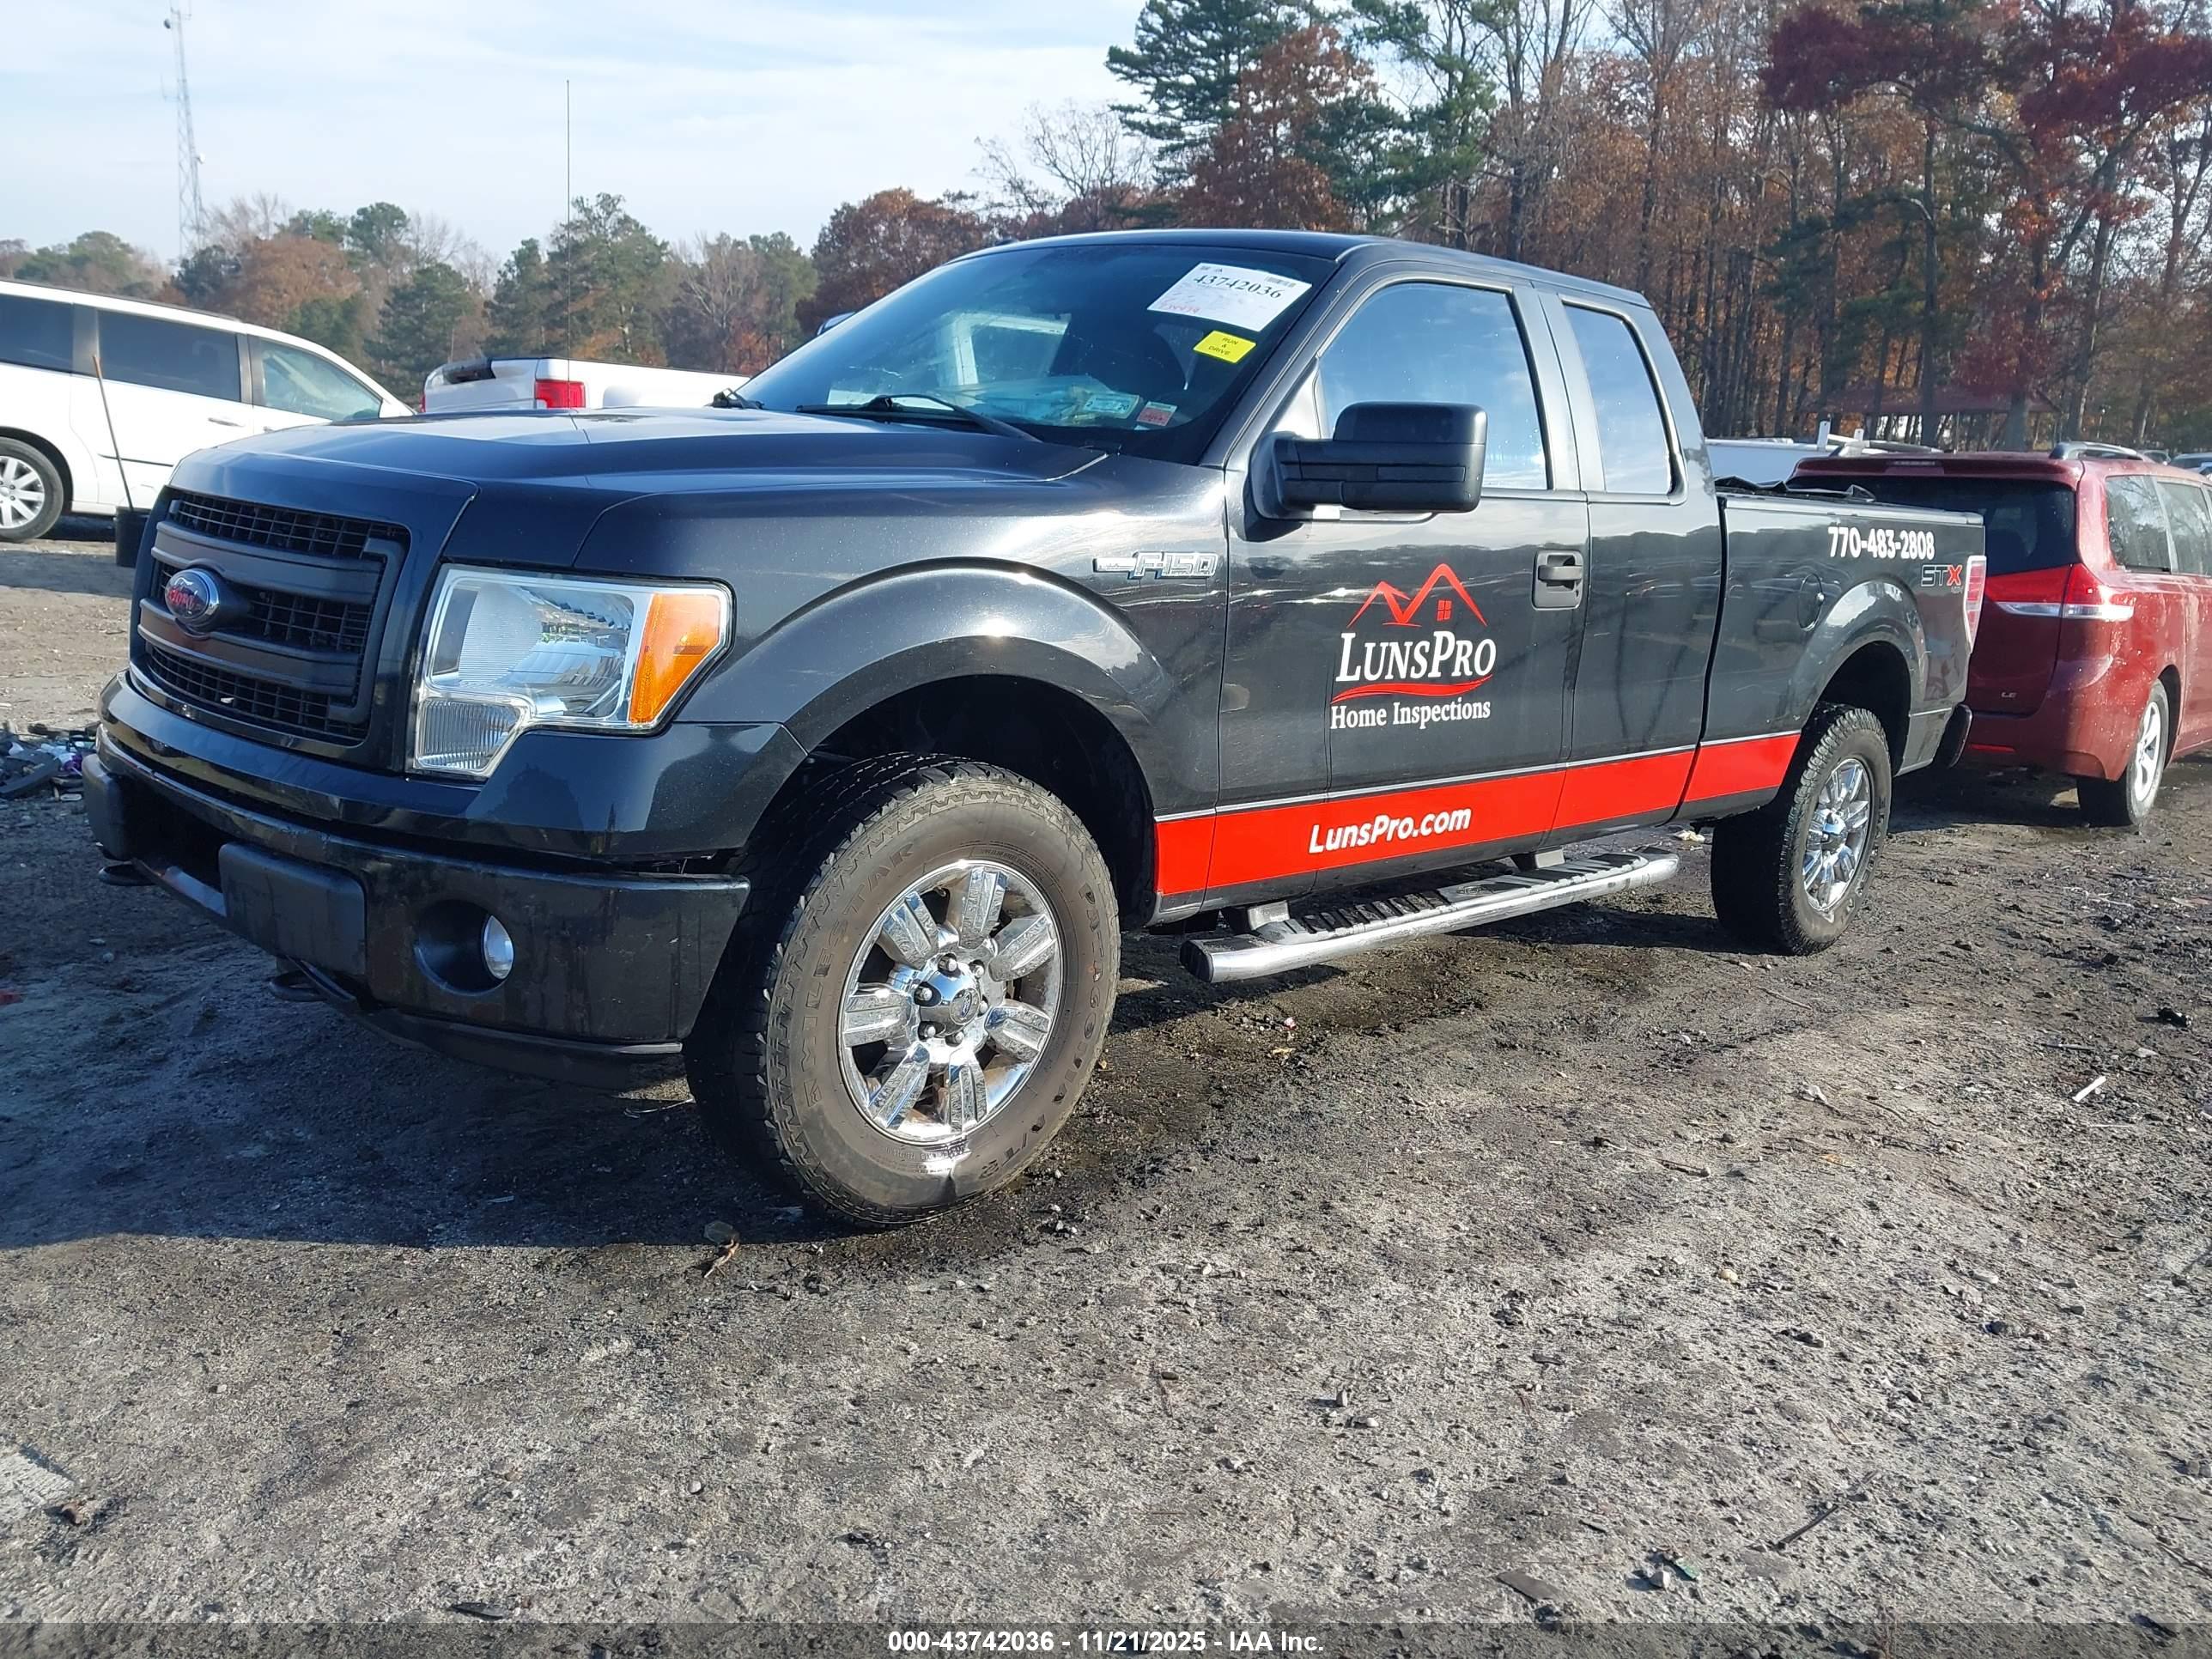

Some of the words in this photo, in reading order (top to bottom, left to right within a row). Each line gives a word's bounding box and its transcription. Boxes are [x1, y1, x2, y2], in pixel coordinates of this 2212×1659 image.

[1194, 274, 1283, 299] 43742036
[1208, 346, 1231, 356] DRIVE
[1222, 336, 1239, 345] RUN
[1827, 526, 1936, 560] 770-483-2808
[1920, 564, 1963, 587] STX
[1330, 704, 1388, 730] Home
[1393, 697, 1492, 730] Inspections
[1308, 808, 1472, 854] LunsPro.com
